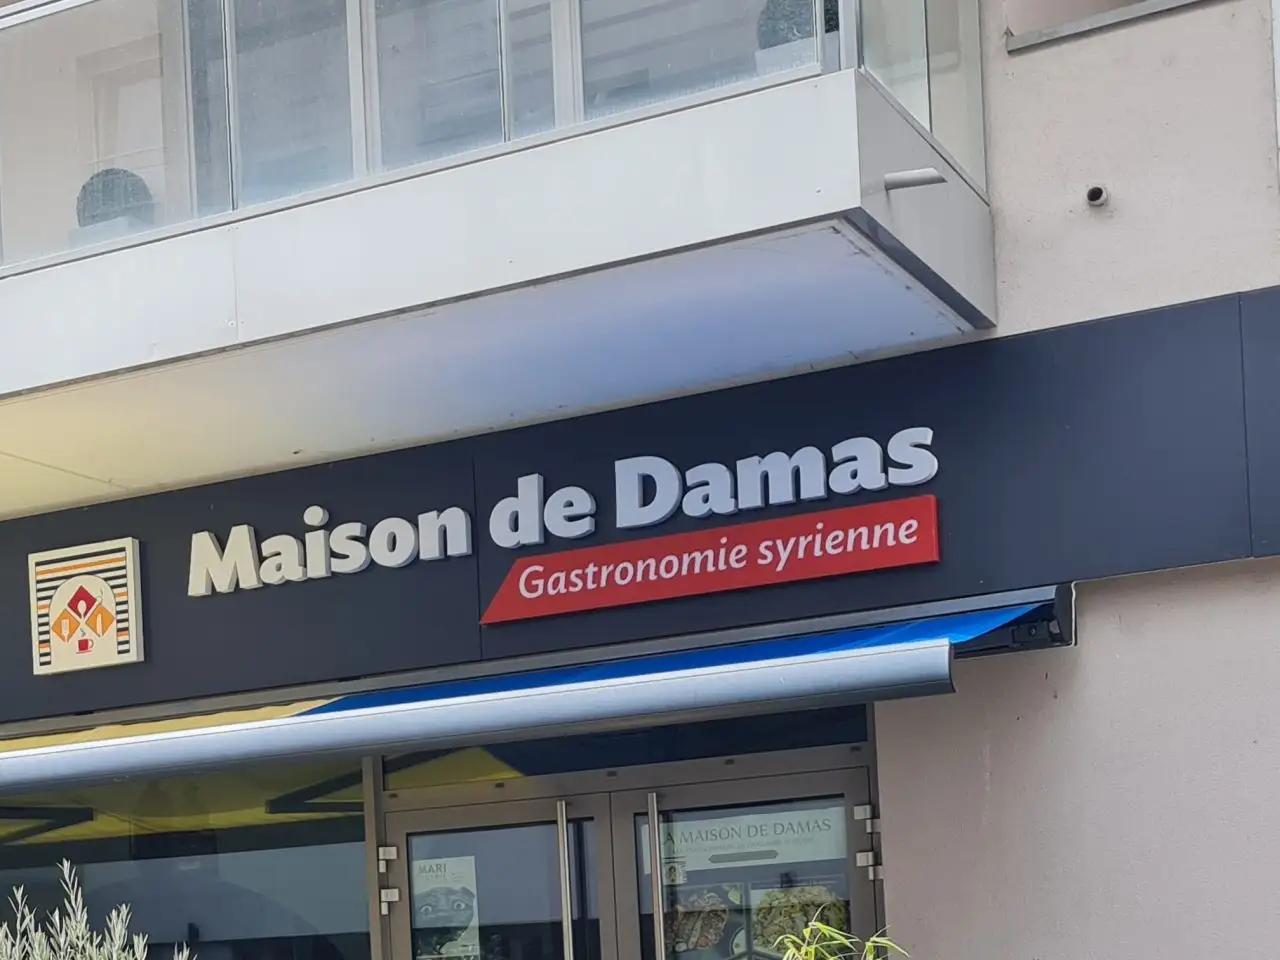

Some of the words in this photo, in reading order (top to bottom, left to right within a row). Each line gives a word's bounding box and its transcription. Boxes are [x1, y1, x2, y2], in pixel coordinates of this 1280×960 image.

[187, 505, 472, 597] Maison
[489, 473, 596, 548] de
[615, 427, 939, 529] Damas
[518, 537, 748, 600] Gastronomie
[757, 518, 919, 572] syrienne
[679, 826, 743, 844] MAISON
[747, 823, 770, 838] DE
[773, 818, 832, 837] DAMAS
